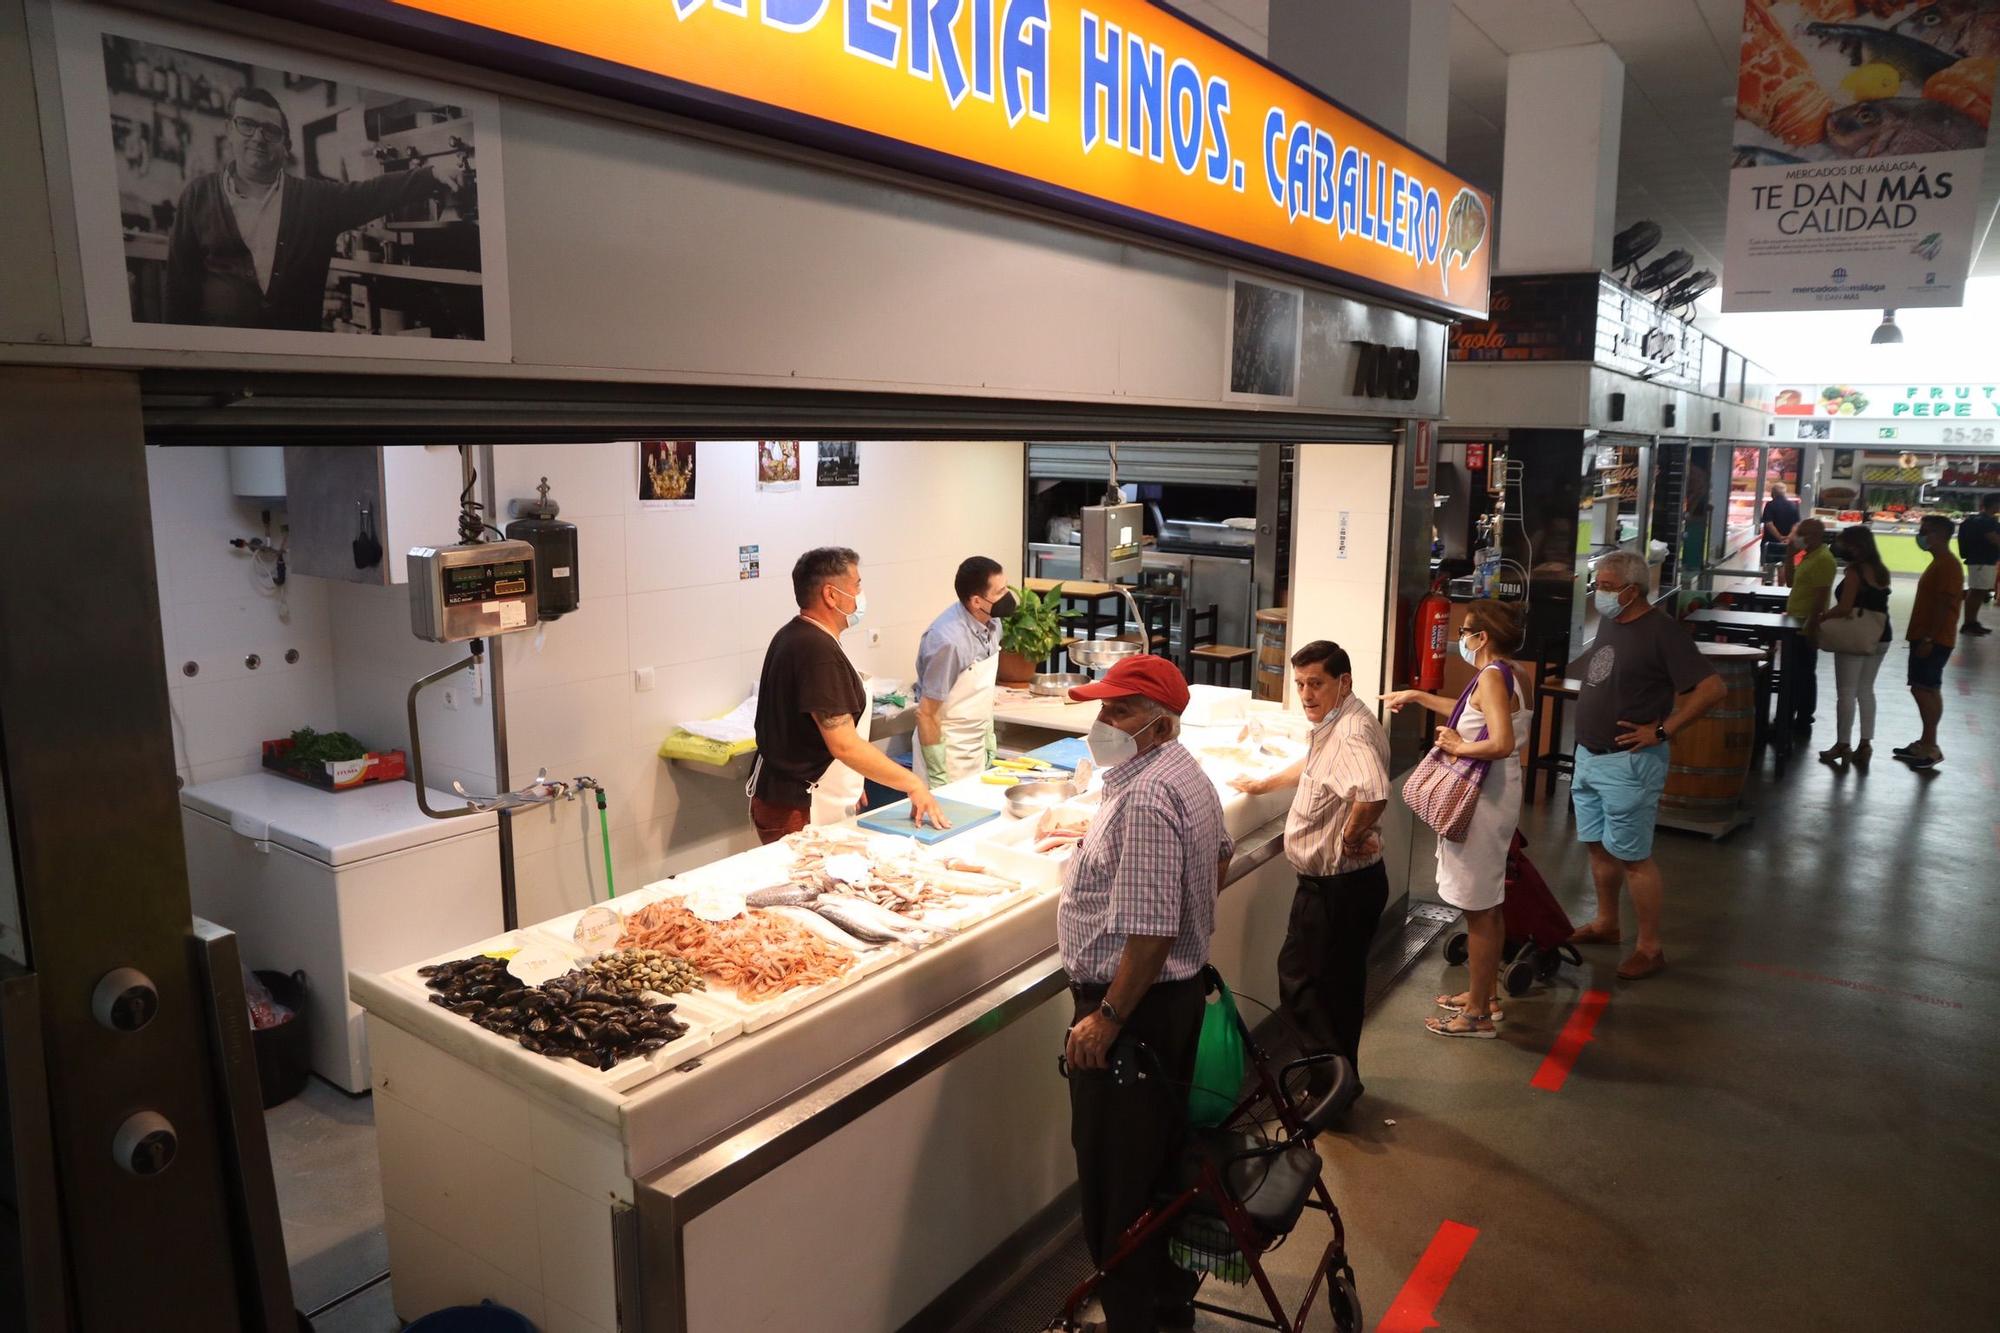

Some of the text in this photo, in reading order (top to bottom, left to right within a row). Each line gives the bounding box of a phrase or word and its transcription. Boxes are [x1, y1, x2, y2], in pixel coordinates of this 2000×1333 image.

[1080, 9, 1244, 193] HNOS.
[1263, 107, 1441, 268] CABALLERO
[1786, 159, 1919, 179] MERCADOS DE MÁLAGA
[1752, 166, 1953, 210] TE DAN MÁS
[1777, 203, 1917, 235] CALIDAD
[1893, 402, 1972, 416] PEPE
[1942, 427, 1995, 443] 25-26
[1499, 582, 1521, 594] TORIA
